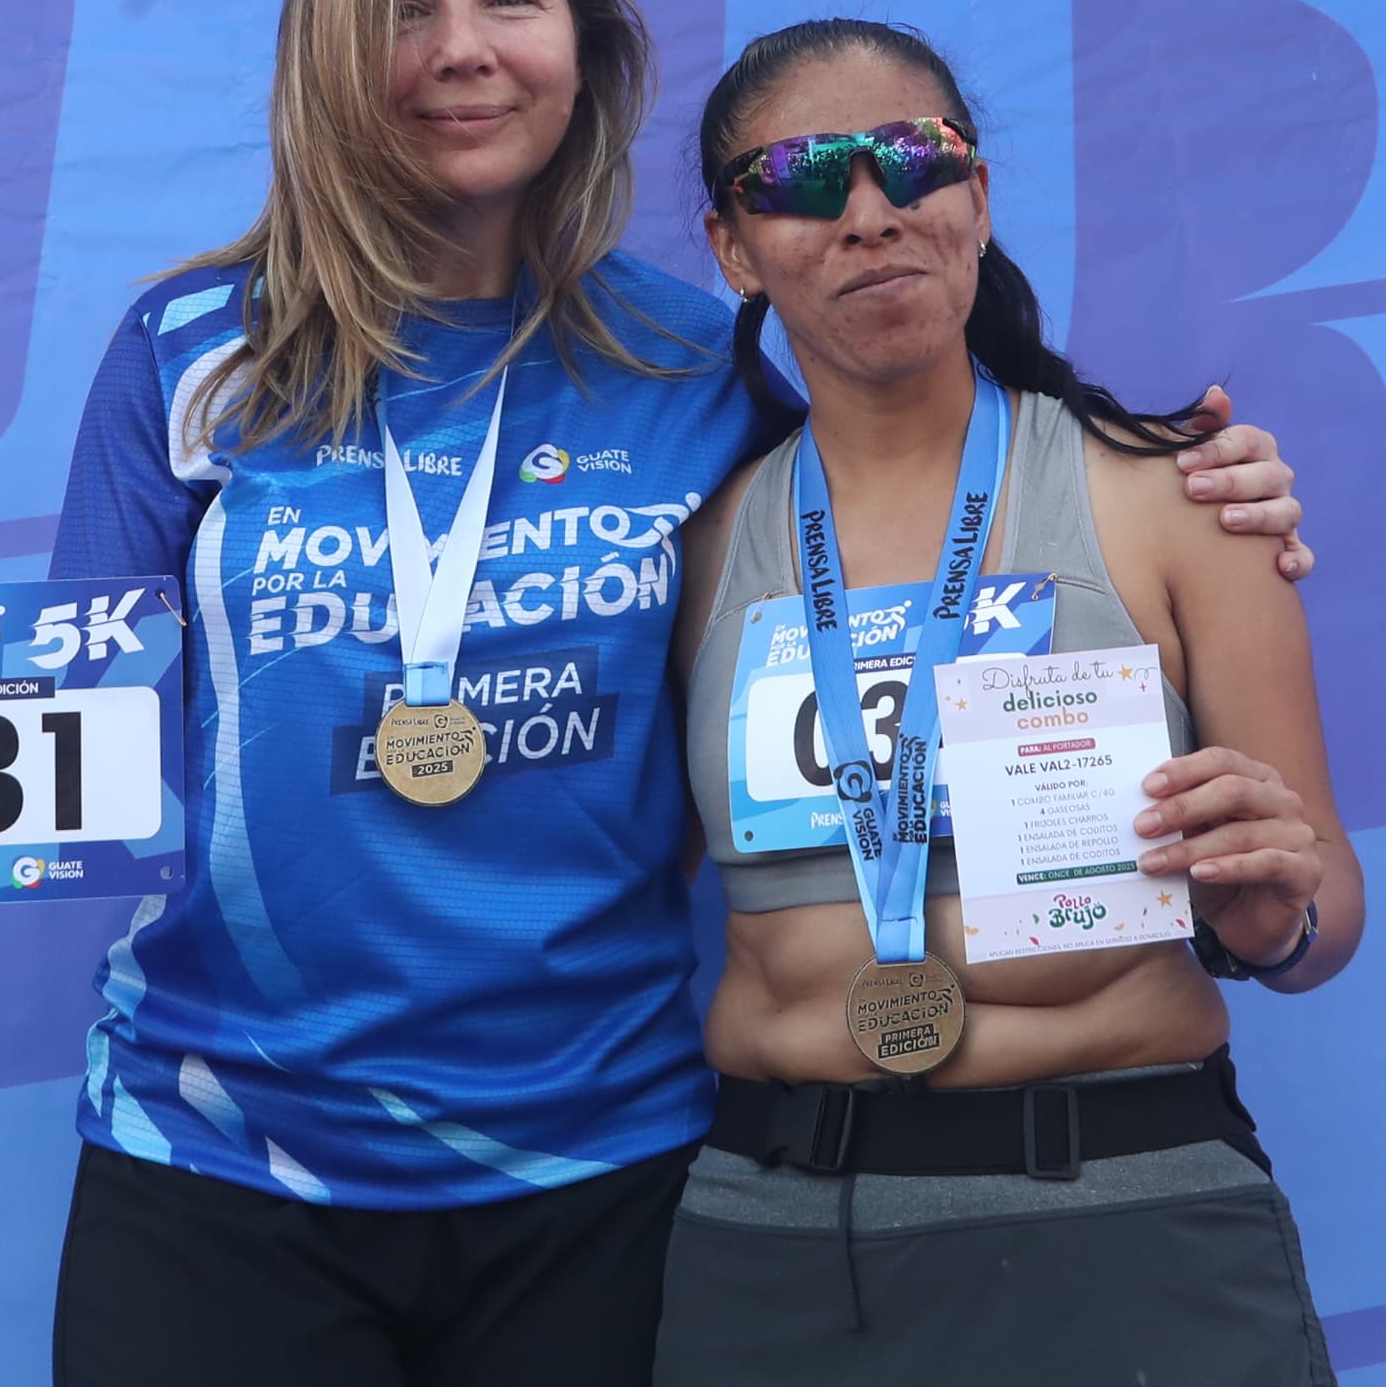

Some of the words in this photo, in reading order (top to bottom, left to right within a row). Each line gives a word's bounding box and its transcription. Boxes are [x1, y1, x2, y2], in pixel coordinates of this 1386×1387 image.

[316, 445, 385, 469] PRENS
[402, 453, 463, 476] LIBRE
[576, 449, 630, 464] GUATE
[576, 459, 632, 475] VISION
[267, 506, 301, 526] EN
[951, 491, 988, 545] LIBRE
[253, 504, 631, 574] MOVENTO
[801, 510, 830, 580] PRENSA
[252, 572, 305, 596] POR
[312, 569, 347, 589] LA
[933, 546, 974, 620] PRENSA
[246, 552, 668, 656] EDUACIÓN
[810, 578, 838, 633] LIBRE
[26, 589, 146, 670] 5K
[889, 655, 915, 667] EDIC
[381, 662, 583, 716] PMERA
[982, 664, 1068, 700] Disfruta
[1071, 661, 1091, 681] de
[1089, 660, 1114, 678] tu
[1003, 690, 1098, 712] delicioso
[1017, 706, 1089, 730] combo
[386, 731, 460, 750] MOVIMIENTO
[417, 762, 449, 775] 2025
[1005, 763, 1037, 777] VALE
[1039, 754, 1113, 772] VAL2-17265
[897, 752, 910, 844] MOVIMIENTO
[1035, 780, 1066, 792] VÁLIDO
[810, 812, 844, 829] PRENS
[852, 809, 874, 861] VISION
[48, 860, 83, 870] GUATE
[48, 869, 84, 879] VISION
[1053, 894, 1092, 910] Pollo
[1048, 902, 1107, 930] Brujo
[858, 990, 937, 1015] MOVIMIENTO
[885, 1026, 931, 1043] PRIMERA
